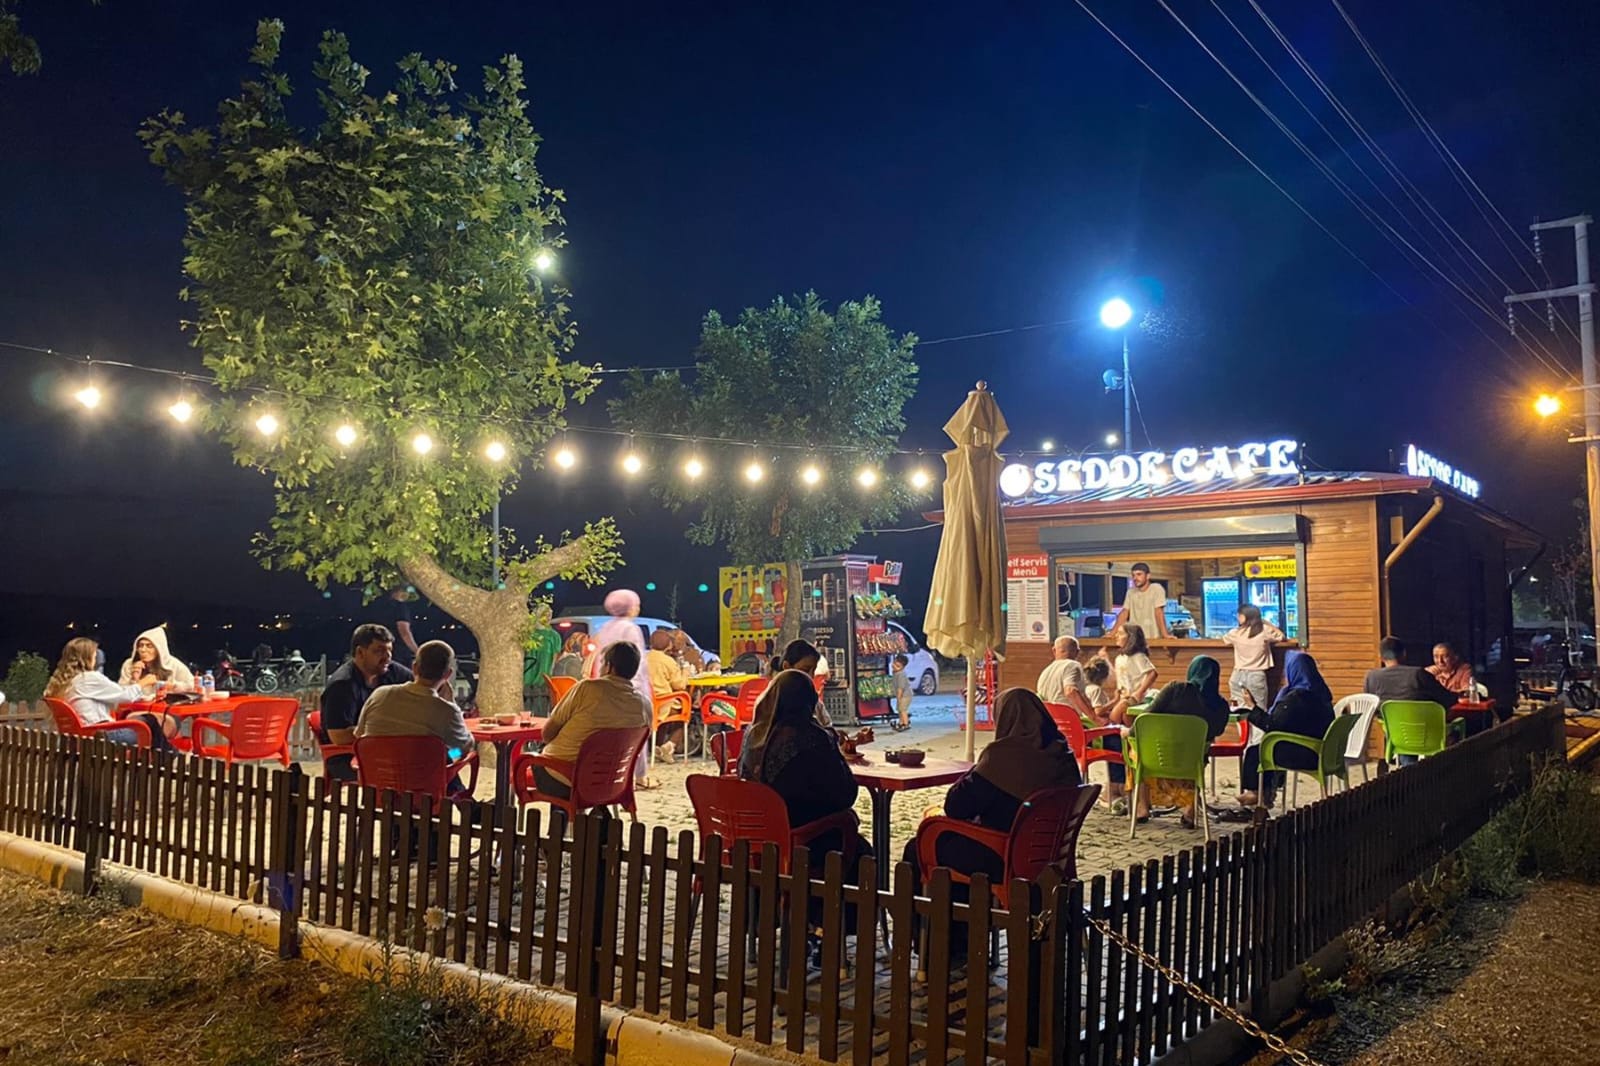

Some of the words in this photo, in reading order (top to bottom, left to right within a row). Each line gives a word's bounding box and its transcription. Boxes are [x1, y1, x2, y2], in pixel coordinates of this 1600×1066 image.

[1034, 452, 1165, 494] SEDDE
[1172, 440, 1299, 482] CAFE
[1007, 557, 1019, 567] elf
[1020, 556, 1047, 567] Servis
[1013, 567, 1038, 576] Menü
